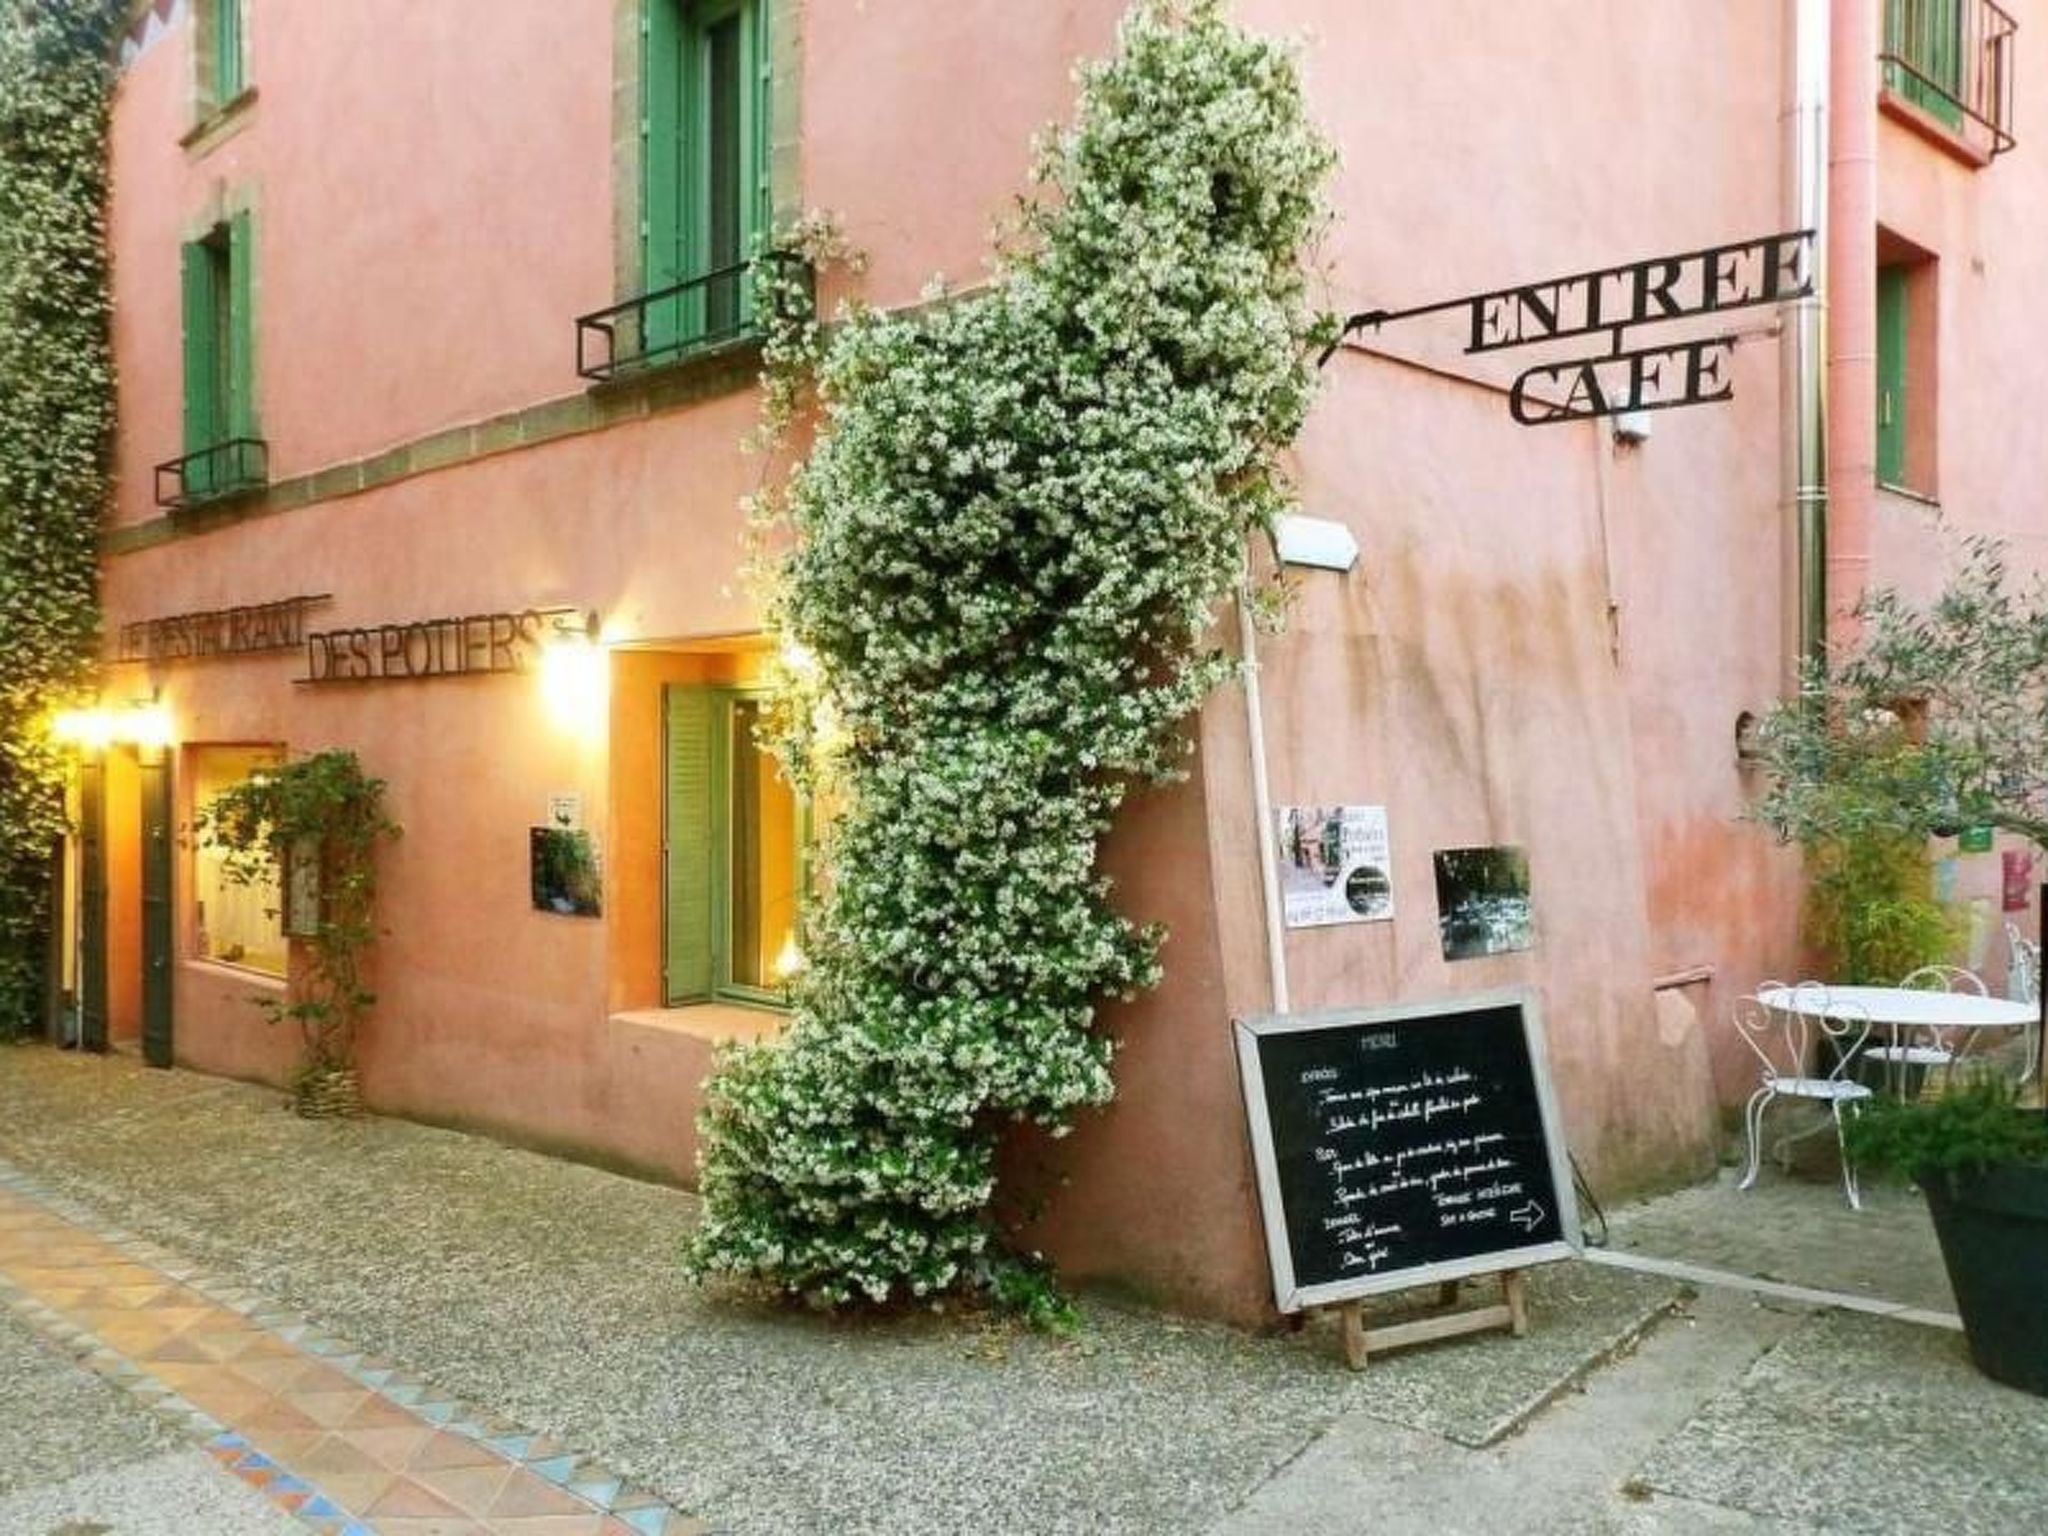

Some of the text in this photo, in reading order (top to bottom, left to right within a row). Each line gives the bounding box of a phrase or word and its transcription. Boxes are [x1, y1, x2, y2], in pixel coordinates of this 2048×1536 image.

[1464, 229, 1816, 354] ENTREE
[1510, 335, 1734, 425] CAFE
[308, 627, 372, 681] DES
